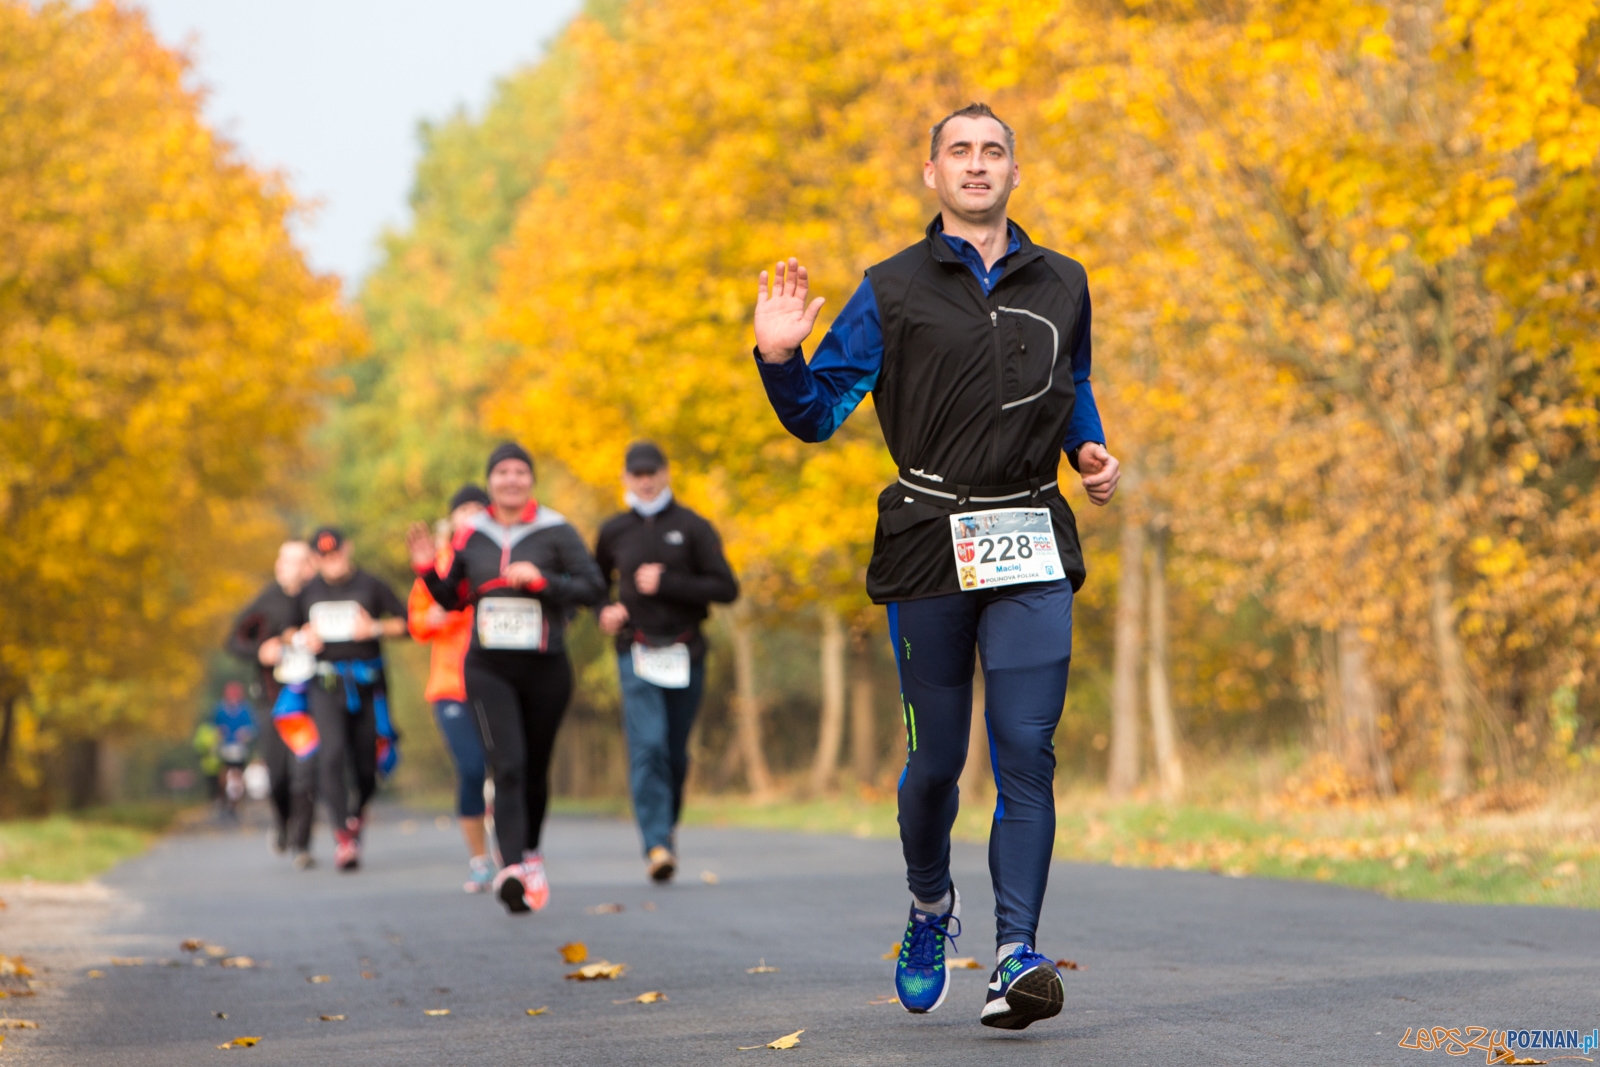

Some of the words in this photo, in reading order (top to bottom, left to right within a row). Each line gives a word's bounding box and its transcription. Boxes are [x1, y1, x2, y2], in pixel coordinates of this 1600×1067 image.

[978, 535, 1033, 563] 228
[996, 564, 1022, 573] Maciej
[986, 575, 1016, 583] POLINOVA
